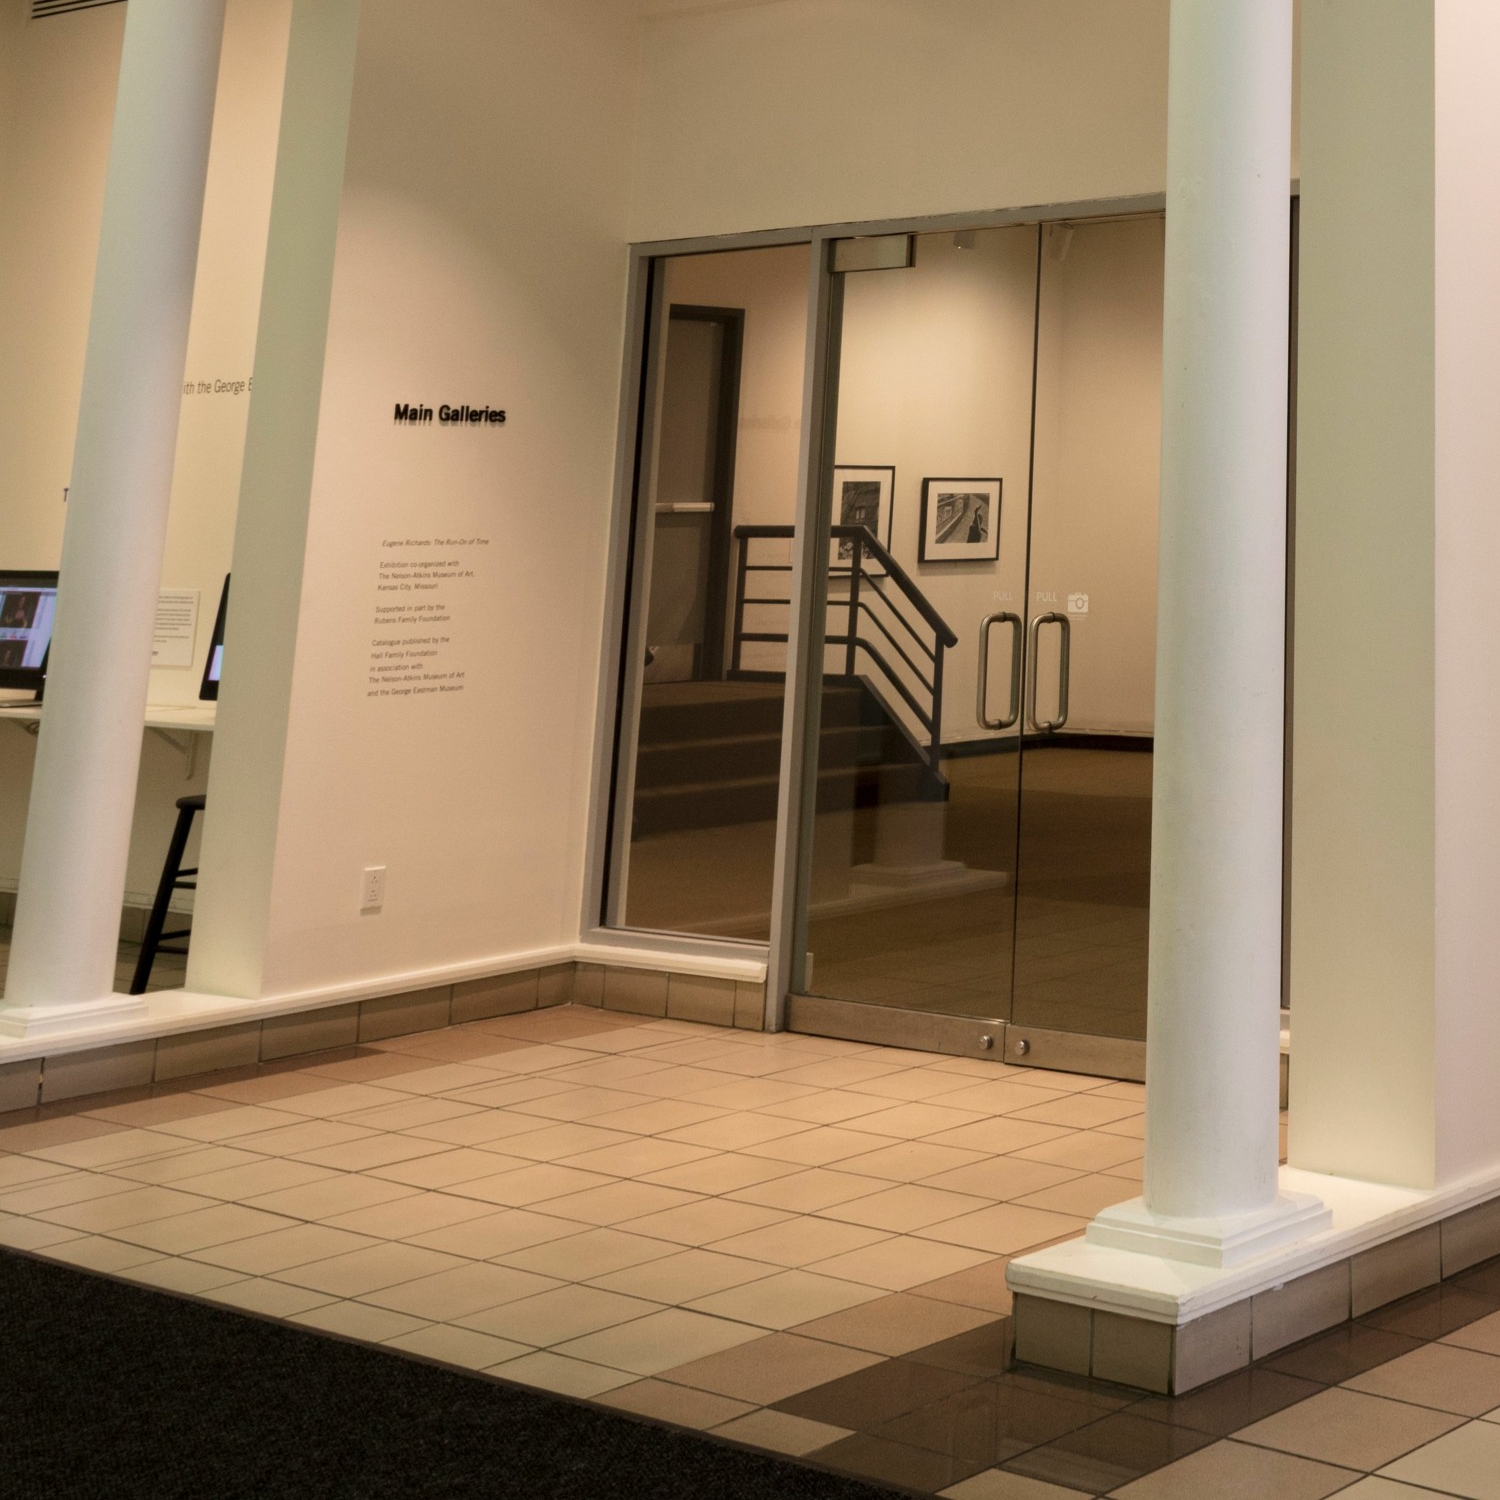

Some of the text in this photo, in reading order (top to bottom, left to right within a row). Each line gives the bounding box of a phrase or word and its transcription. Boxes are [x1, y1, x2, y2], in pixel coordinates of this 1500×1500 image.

[183, 381, 195, 395] ith
[197, 380, 211, 394] the
[214, 379, 245, 395] George
[393, 403, 506, 423] Main Galleries
[1037, 591, 1057, 602] PULL
